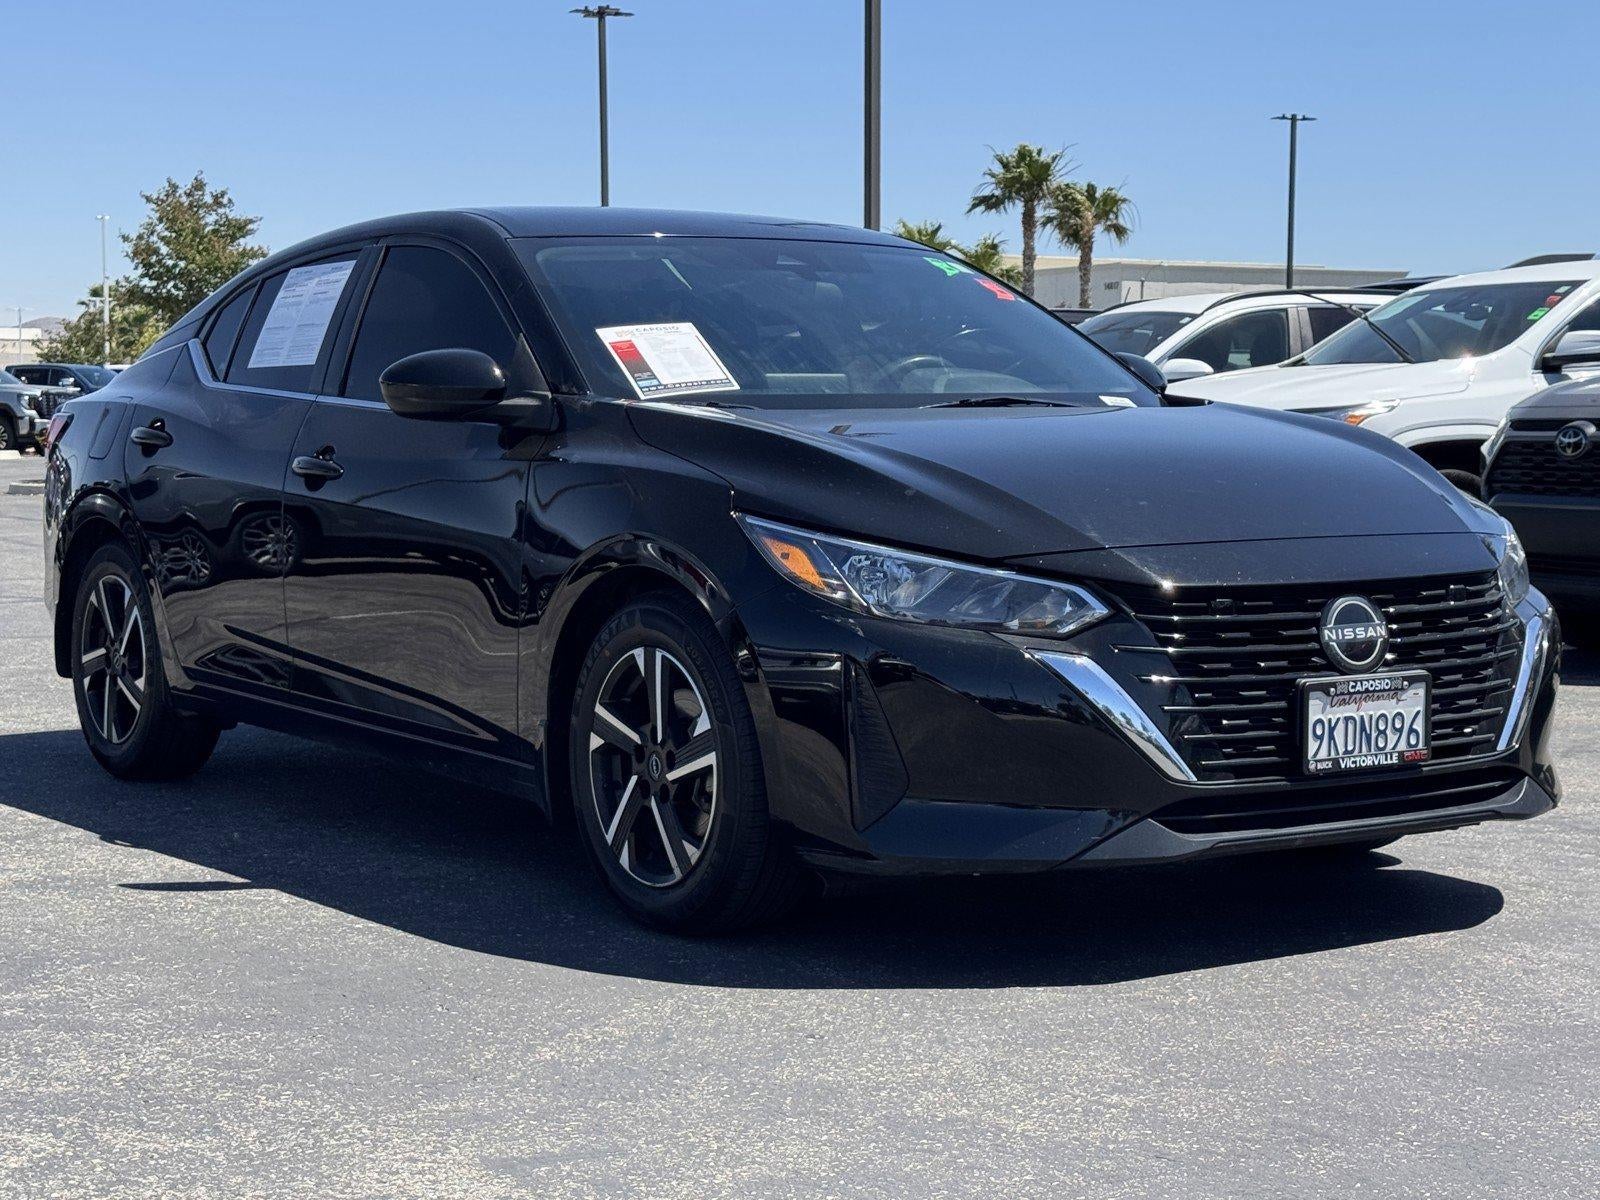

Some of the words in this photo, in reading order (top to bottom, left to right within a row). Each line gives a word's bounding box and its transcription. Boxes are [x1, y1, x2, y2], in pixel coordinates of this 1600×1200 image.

[1324, 624, 1387, 641] NISSAN
[1348, 680, 1390, 693] CAPOSIO
[1330, 692, 1406, 711] California
[1312, 709, 1422, 758] 9KDN896
[1317, 760, 1333, 770] BUICK
[1339, 753, 1399, 769] VICTORVILLE
[1403, 750, 1428, 761] GMC
